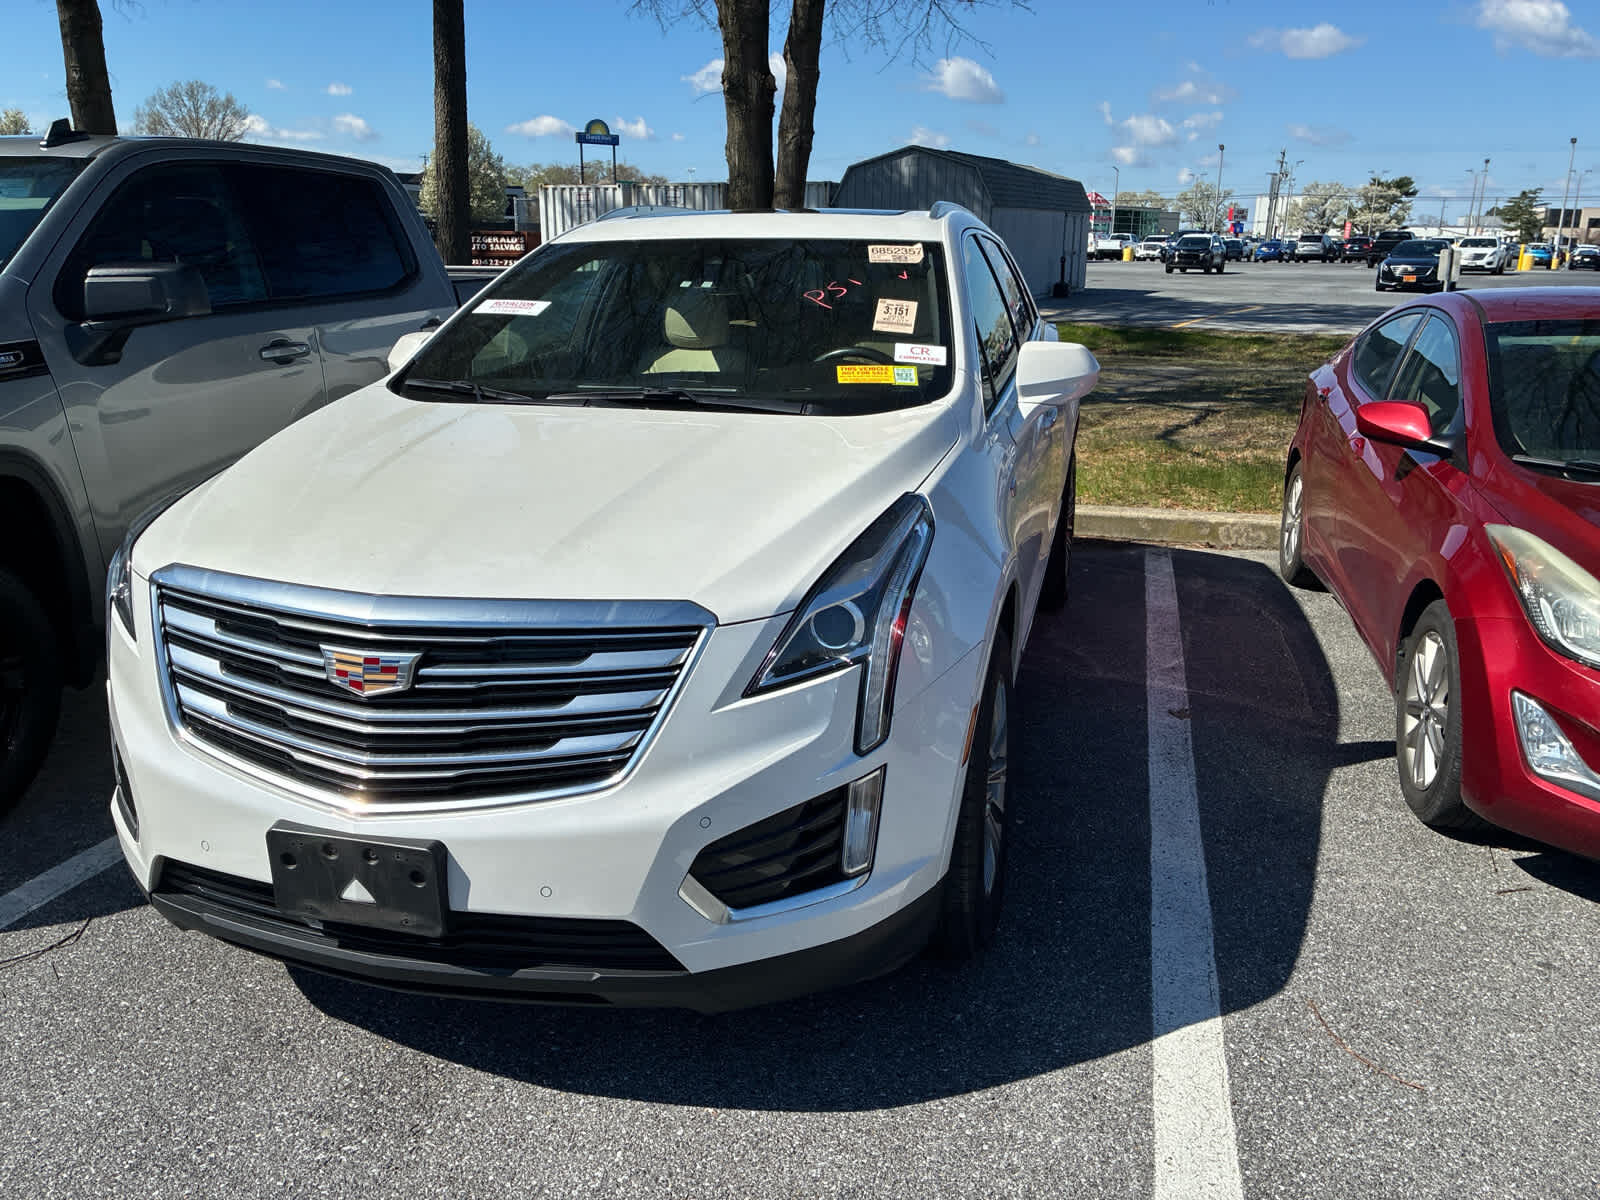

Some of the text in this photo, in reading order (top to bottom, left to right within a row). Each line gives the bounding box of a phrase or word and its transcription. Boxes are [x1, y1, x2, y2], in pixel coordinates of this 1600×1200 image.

[489, 243, 525, 251] SALVAGE
[871, 247, 921, 255] 6852357
[909, 346, 930, 355] CR
